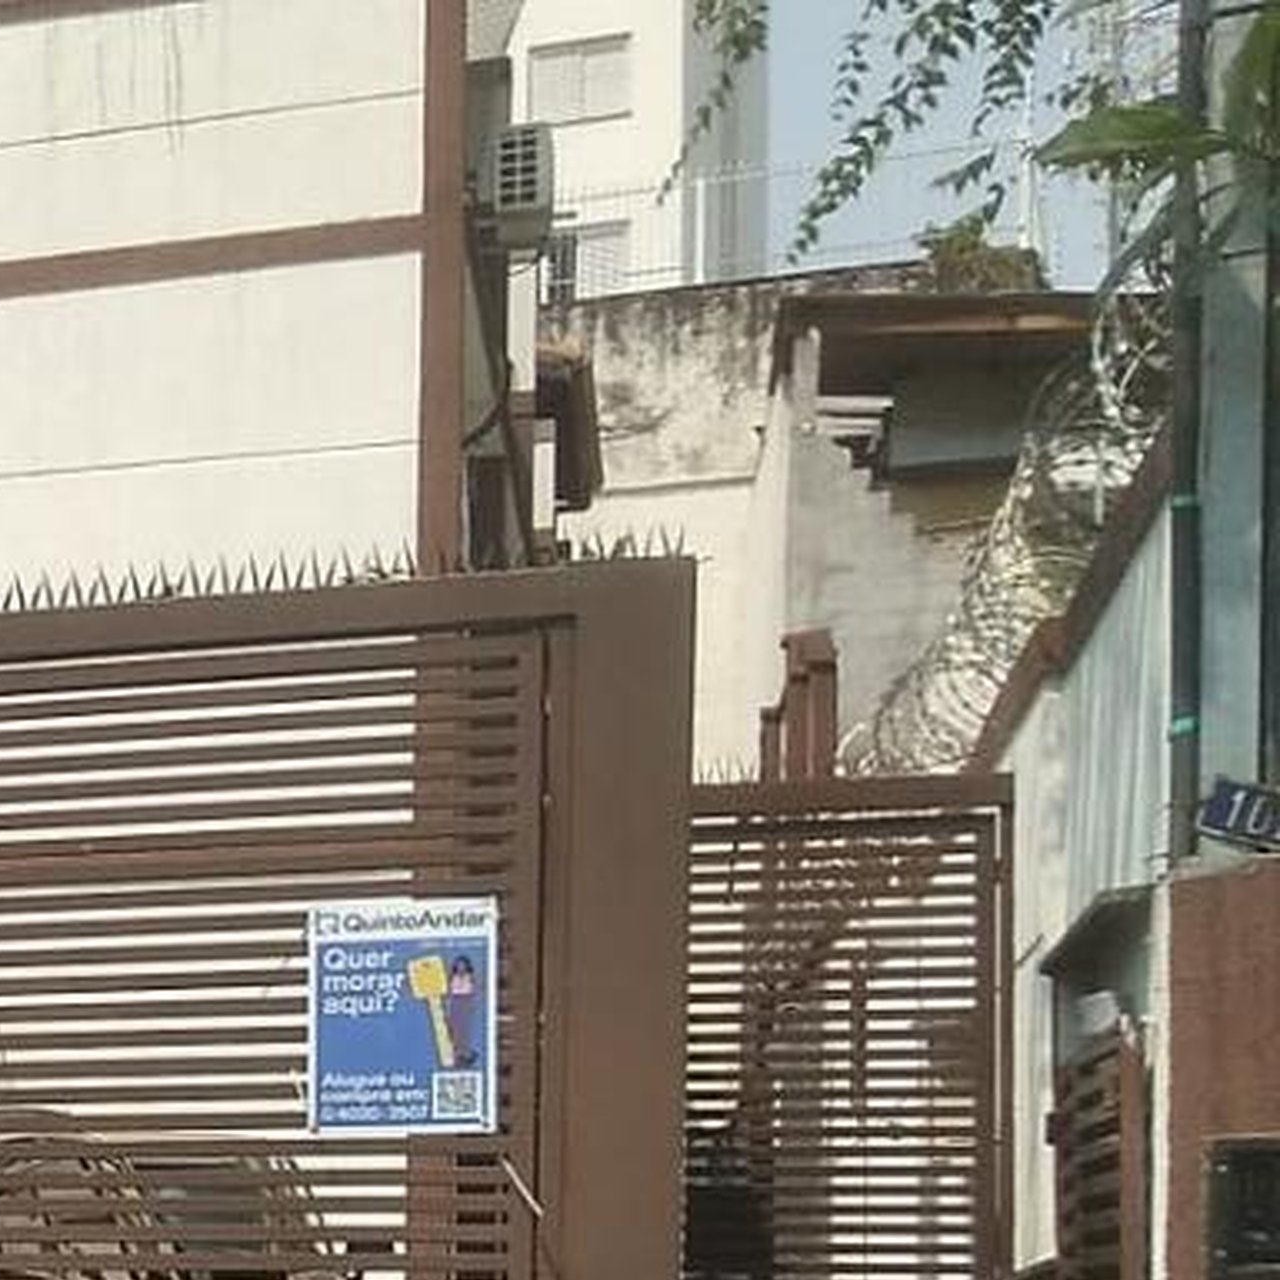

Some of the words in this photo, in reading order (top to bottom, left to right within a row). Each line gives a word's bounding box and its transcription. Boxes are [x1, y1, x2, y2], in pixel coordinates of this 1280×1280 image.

[343, 909, 487, 933] QuintoAndar
[323, 947, 394, 970] Quer
[322, 972, 406, 991] morar
[322, 991, 400, 1017] aqui?
